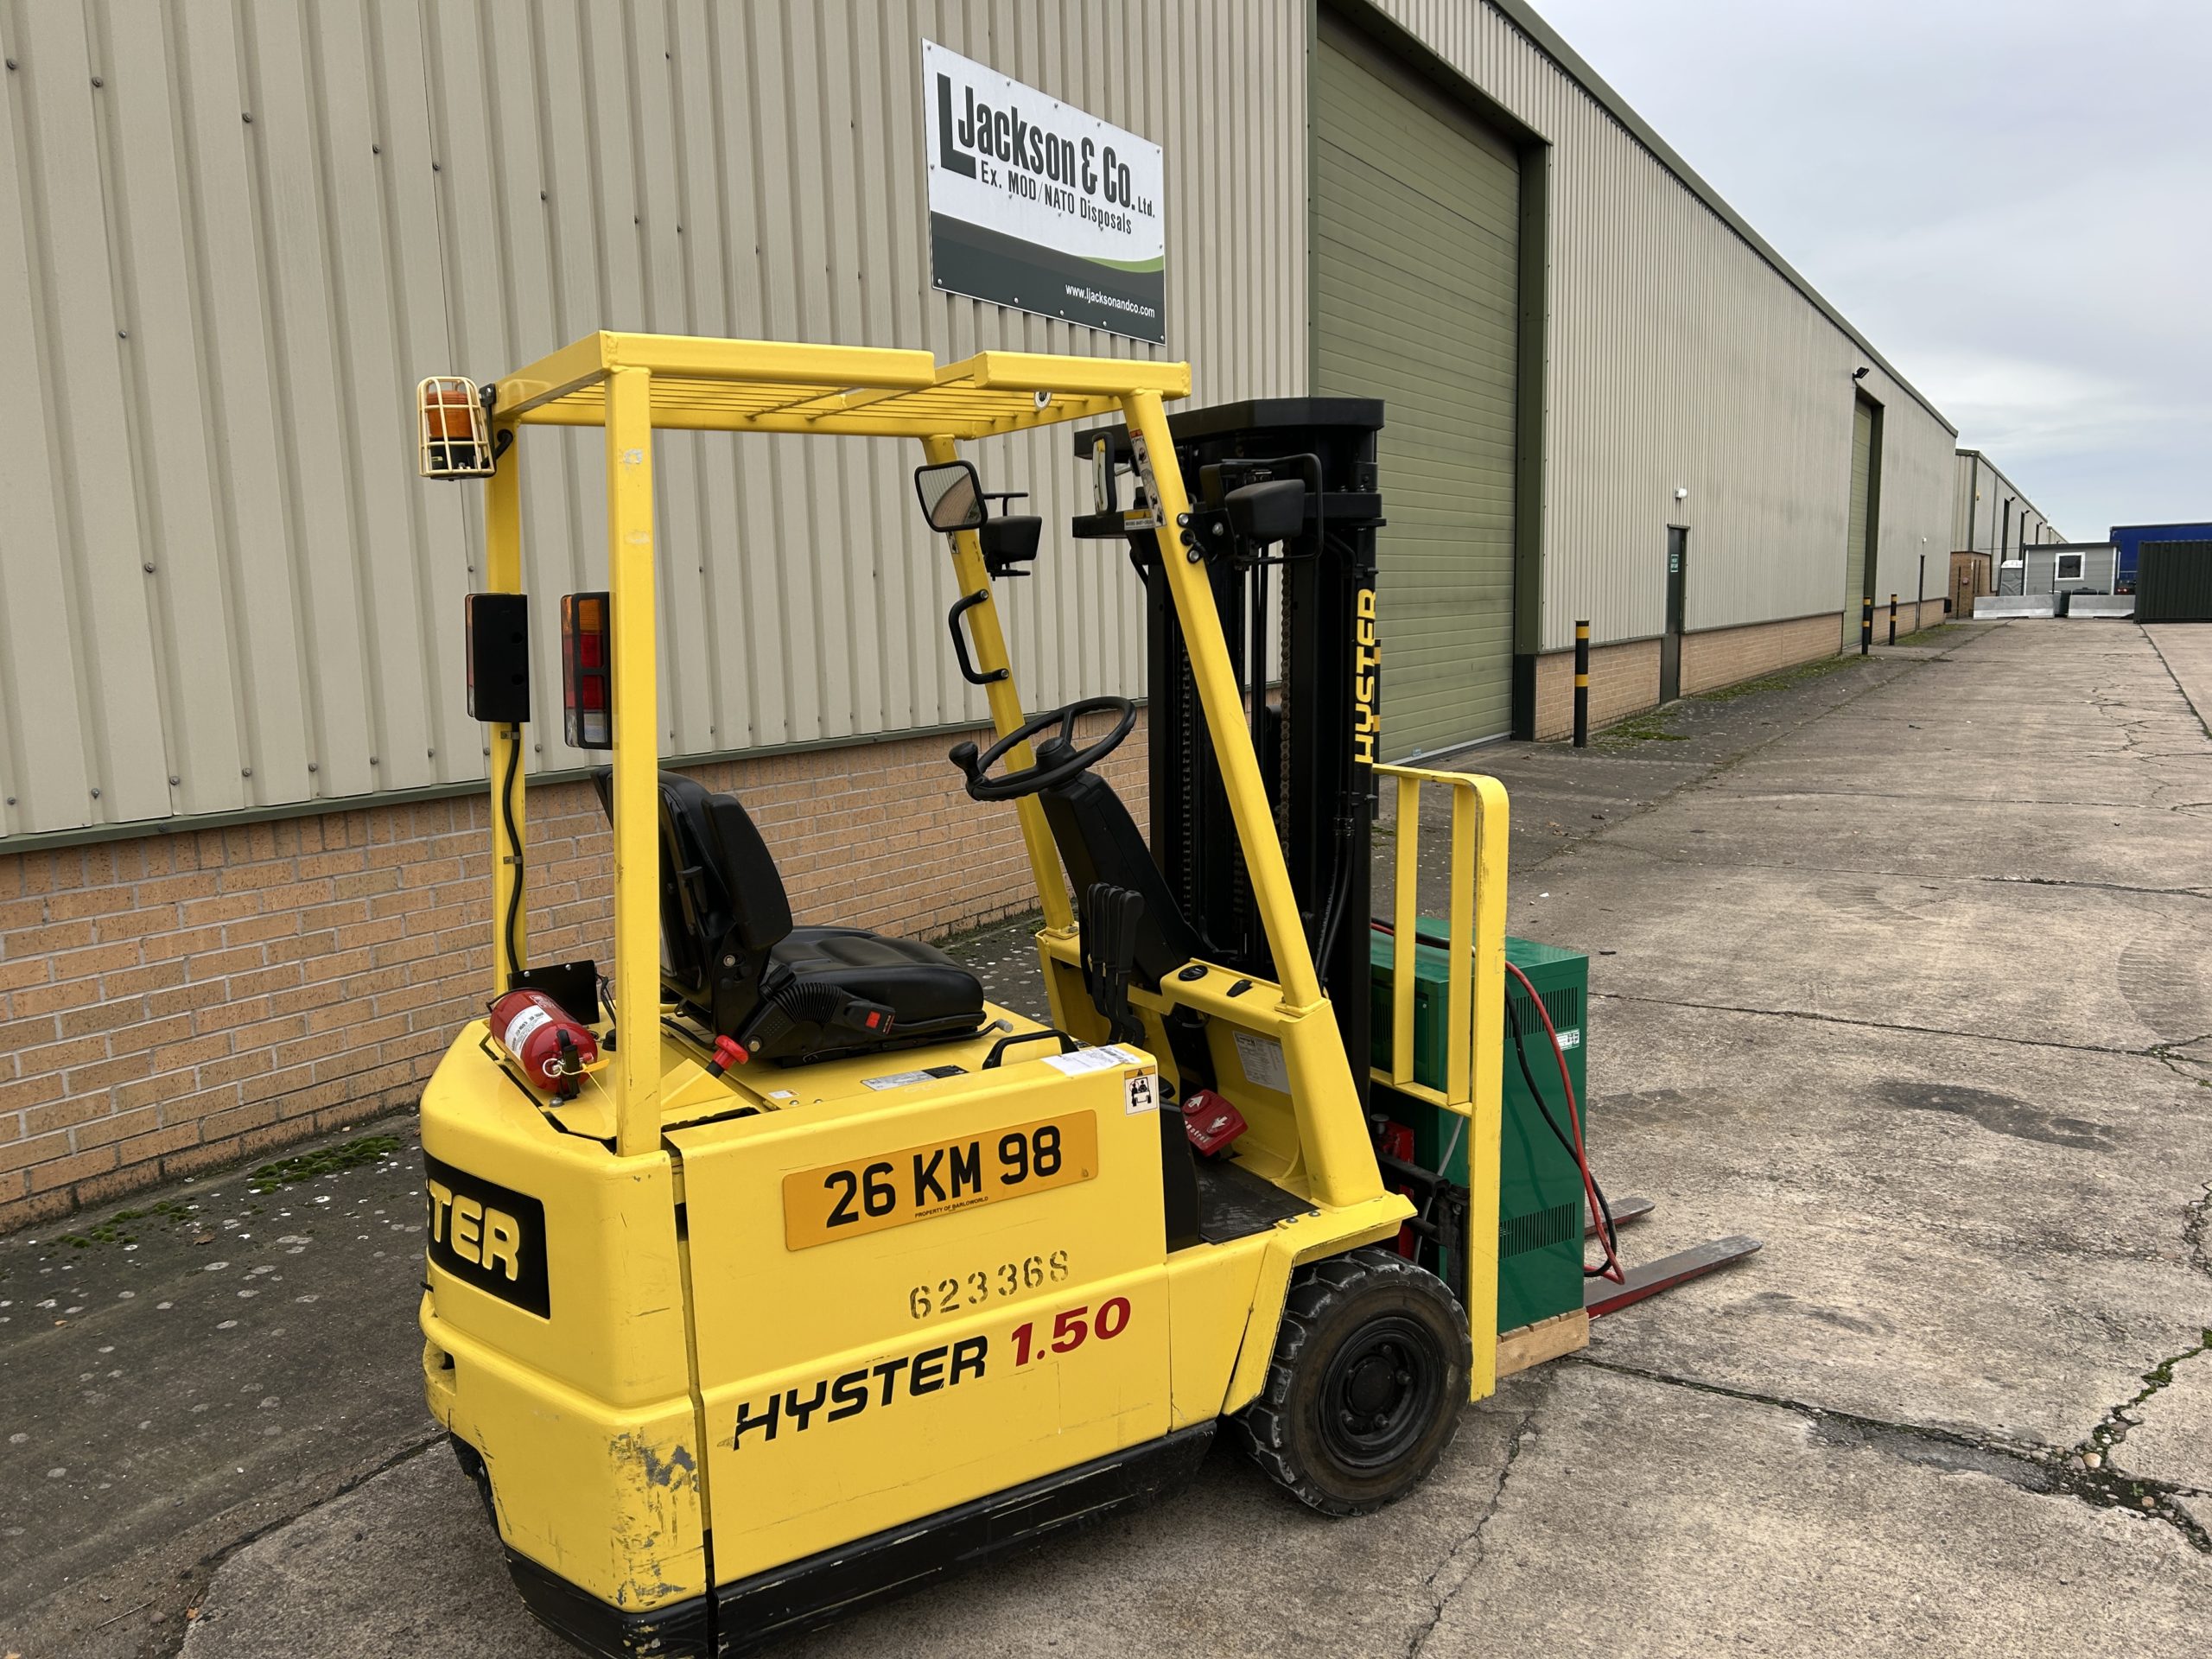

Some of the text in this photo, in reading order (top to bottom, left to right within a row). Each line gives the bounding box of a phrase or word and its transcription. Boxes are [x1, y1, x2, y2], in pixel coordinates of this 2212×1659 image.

[957, 85, 1076, 188] Jackson
[1081, 137, 1098, 195] &
[1103, 145, 1136, 211] Co.
[1137, 195, 1155, 218] Ltd.
[1080, 197, 1132, 235] Disposals
[1065, 283, 1155, 319] www.ljacksonandco.com
[1354, 588, 1376, 765] HYSTER
[823, 1125, 1062, 1229] 26 KM 98
[915, 1206, 944, 1218] PROPERTY
[952, 1196, 988, 1210] BARLOWORLD
[428, 1178, 520, 1282] TER
[733, 1296, 1132, 1452] HYSTER 1.50
